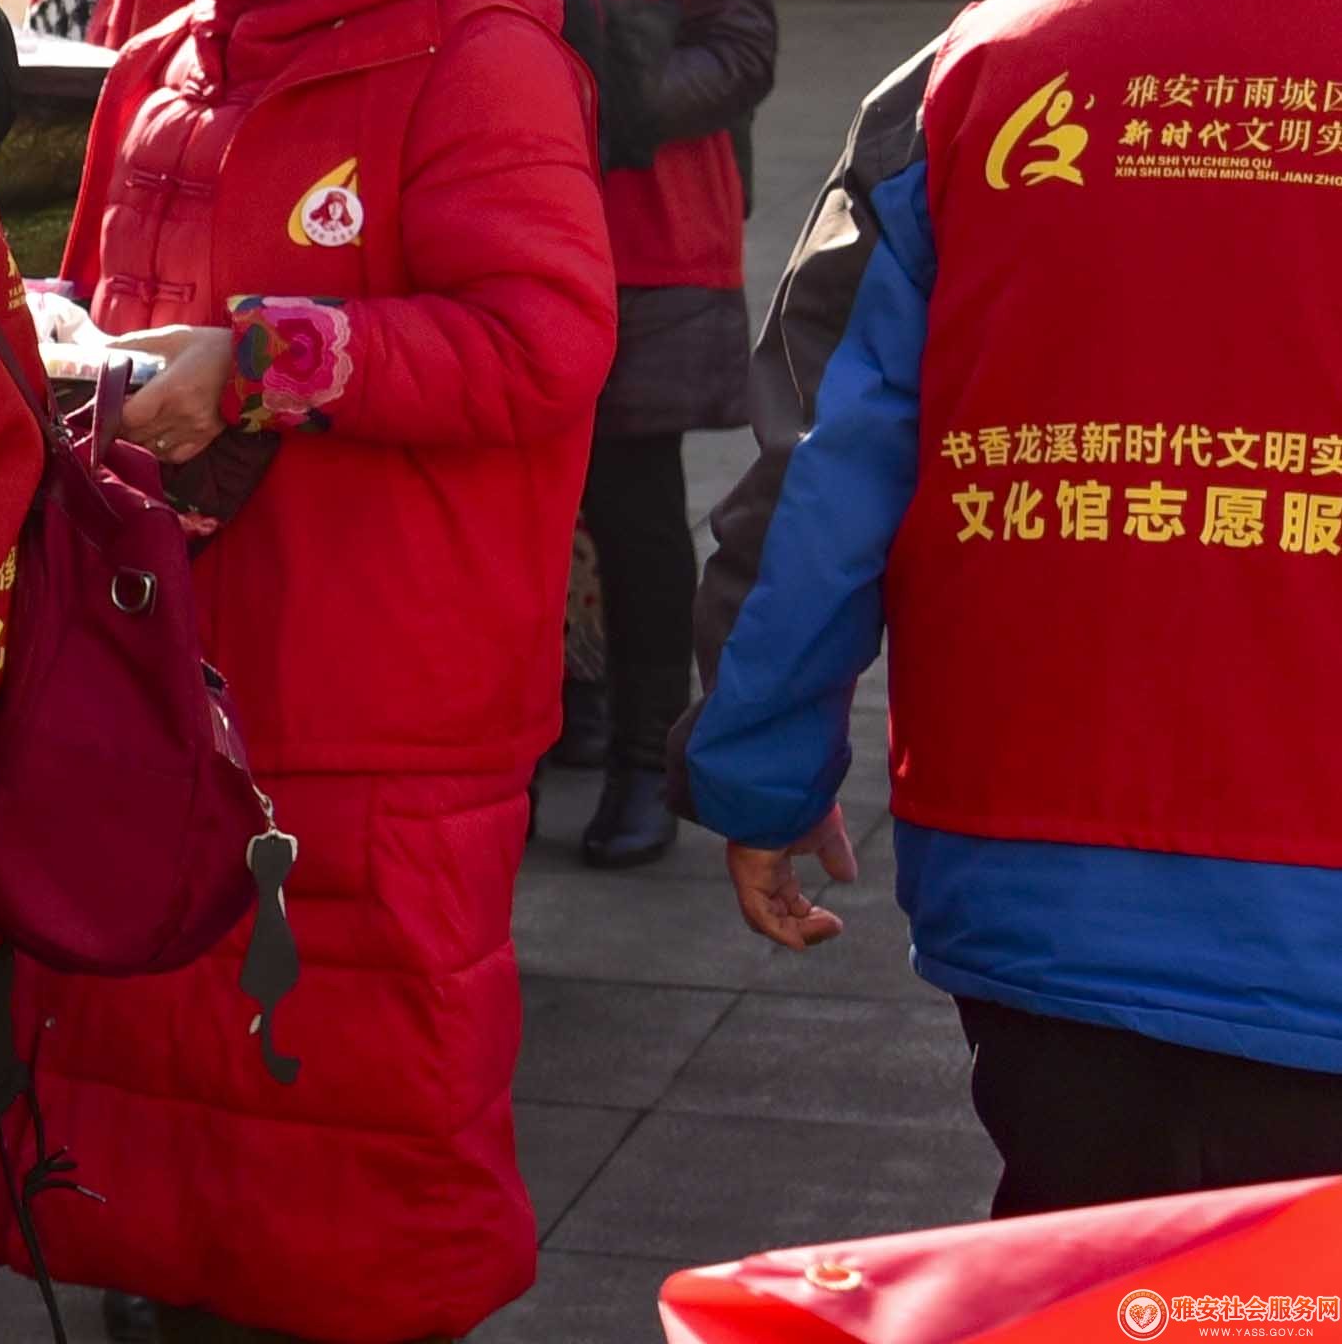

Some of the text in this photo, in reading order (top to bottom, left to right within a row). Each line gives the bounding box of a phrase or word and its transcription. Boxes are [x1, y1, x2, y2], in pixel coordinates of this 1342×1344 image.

[1115, 166, 1137, 177] XIN
[1139, 167, 1161, 177] SHI
[1163, 167, 1185, 177] DAI
[1187, 168, 1217, 179] WEN
[1219, 169, 1254, 181] MING
[1256, 170, 1279, 181] SHI
[1280, 172, 1313, 184] JIAN
[1116, 155, 1272, 170] YA AN SHI YU CHENG QU
[940, 422, 1342, 476] 书香龙溪新时代文明实
[952, 480, 1342, 556] 文化馆志愿服
